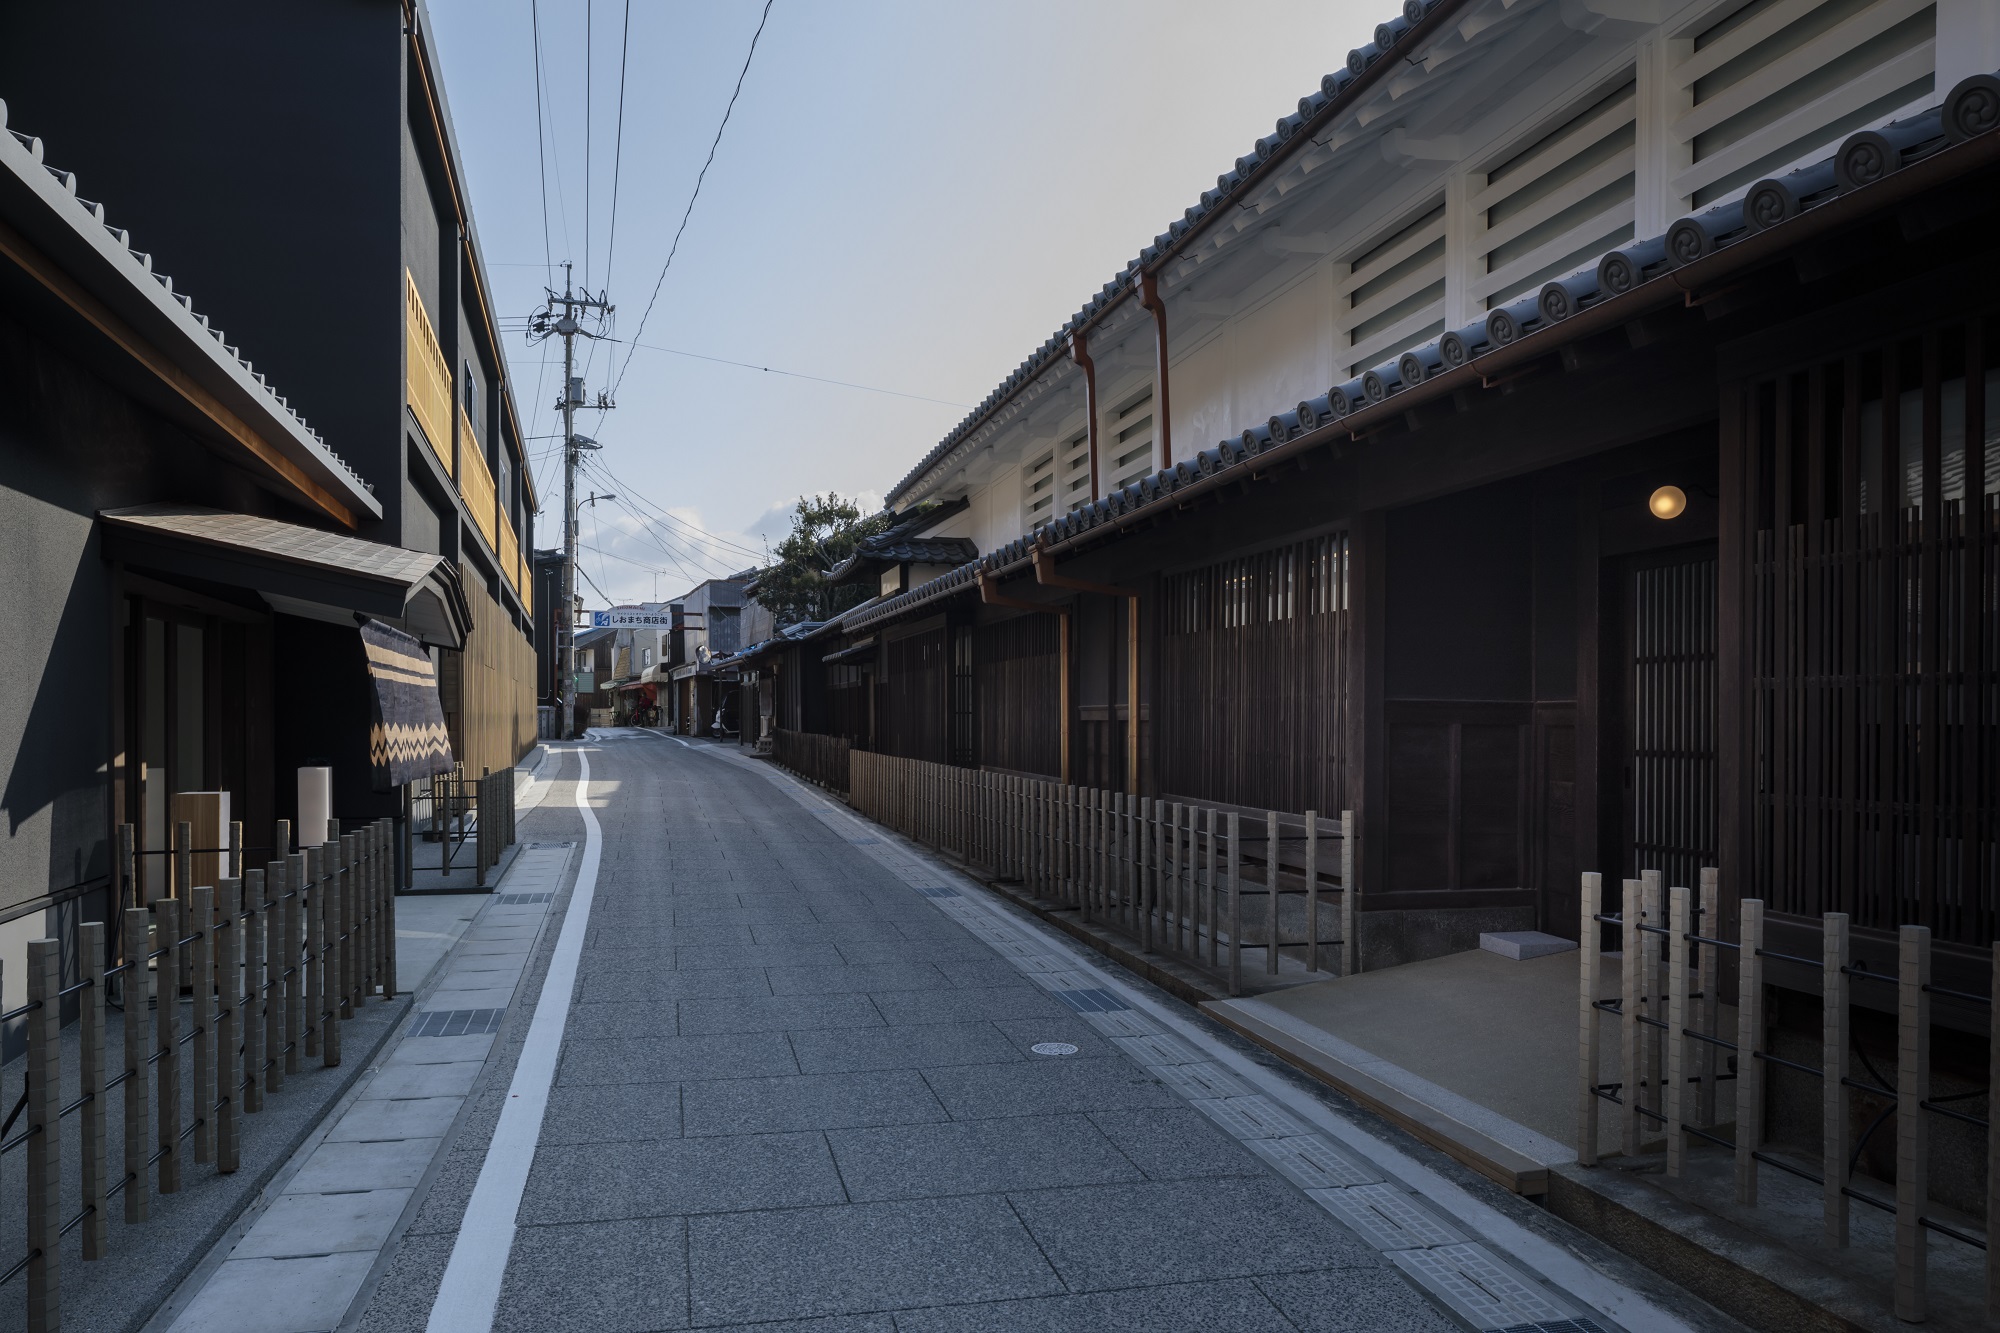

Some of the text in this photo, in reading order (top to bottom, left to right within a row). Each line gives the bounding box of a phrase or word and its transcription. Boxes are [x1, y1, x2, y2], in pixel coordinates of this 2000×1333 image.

[612, 616, 668, 624] しおまち商店街
